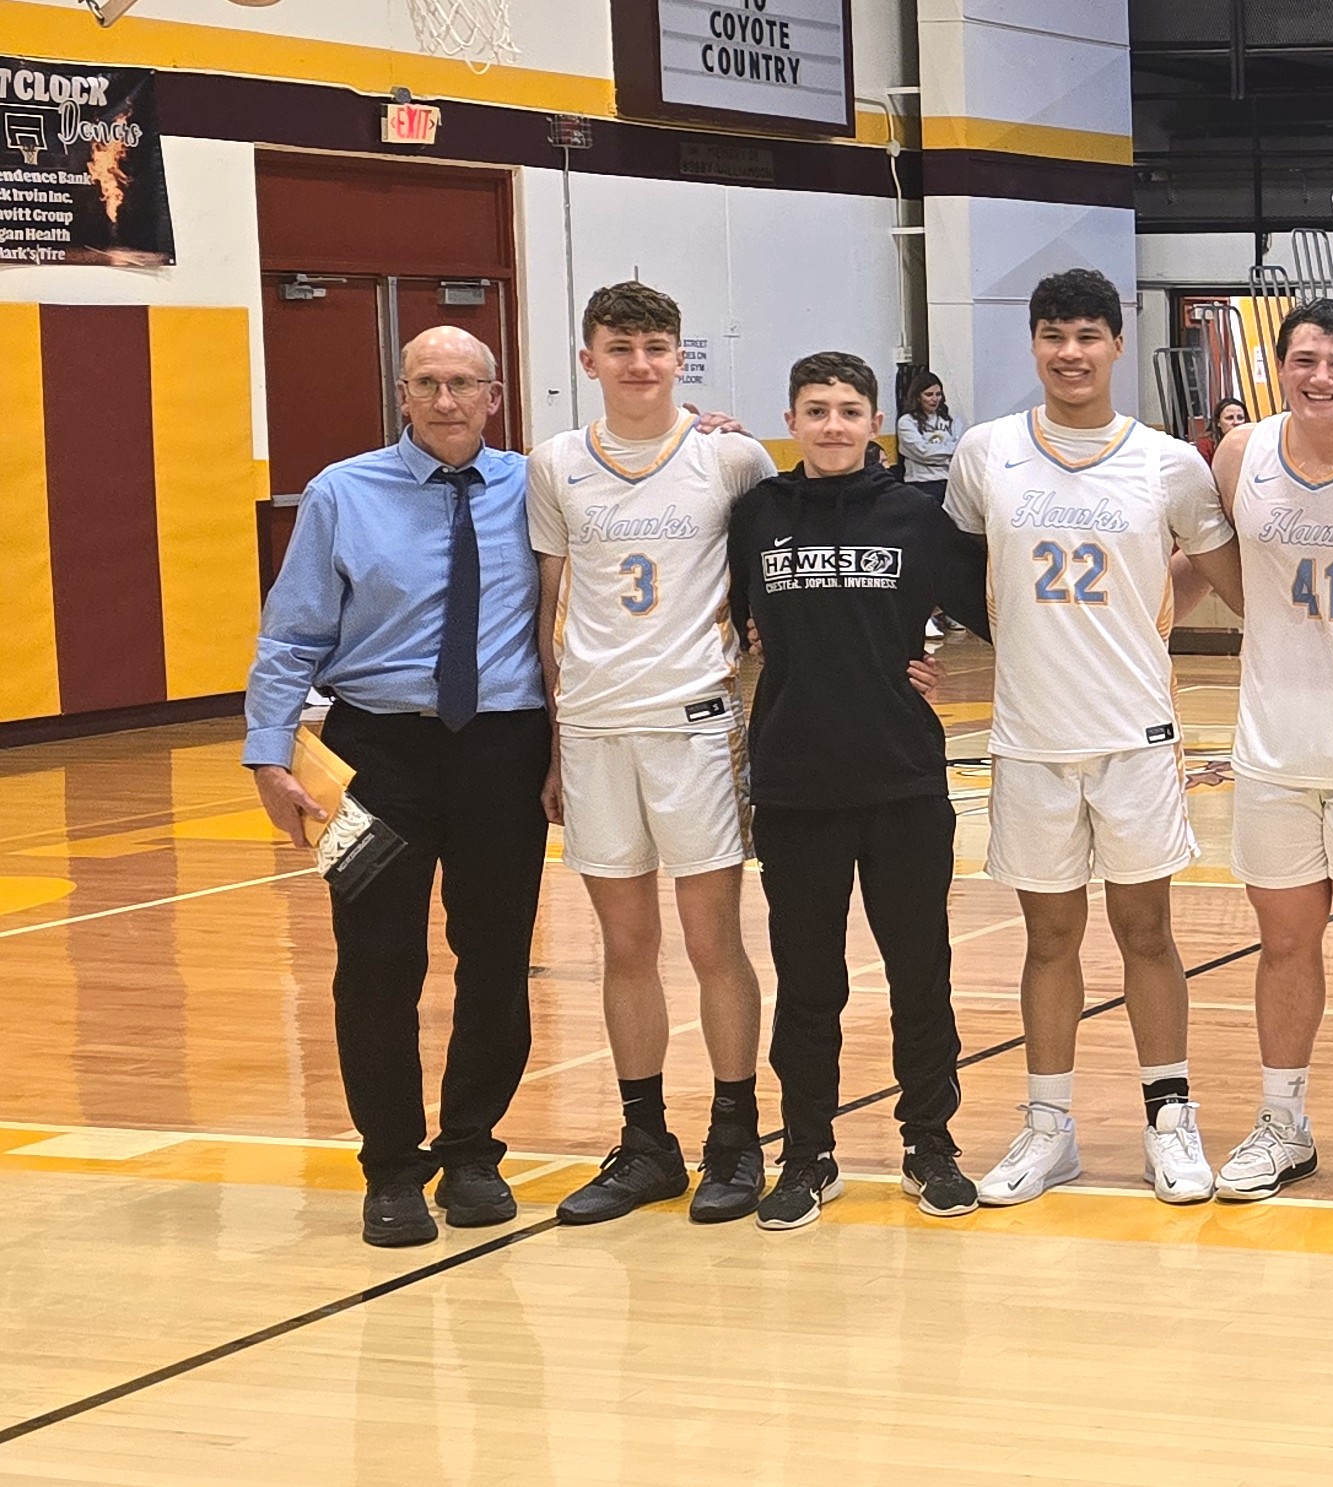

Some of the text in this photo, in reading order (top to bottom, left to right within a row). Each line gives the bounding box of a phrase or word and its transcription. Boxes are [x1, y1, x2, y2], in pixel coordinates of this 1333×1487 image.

[710, 11, 790, 50] COYOTE
[702, 44, 800, 85] COUNTRY
[14, 69, 110, 106] CLOCK
[58, 99, 143, 155] Donors
[397, 107, 432, 139] EXIT
[13, 188, 47, 203] Irvin
[49, 190, 73, 203] Inc.
[58, 172, 92, 185] Bank
[26, 228, 71, 242] Health
[33, 209, 74, 226] Group
[40, 247, 66, 260] Tire
[580, 503, 699, 543] Hawks
[1010, 489, 1130, 533] Hawks
[766, 553, 853, 574] HAWKS
[1032, 539, 1108, 605] 22
[618, 552, 658, 616] 3
